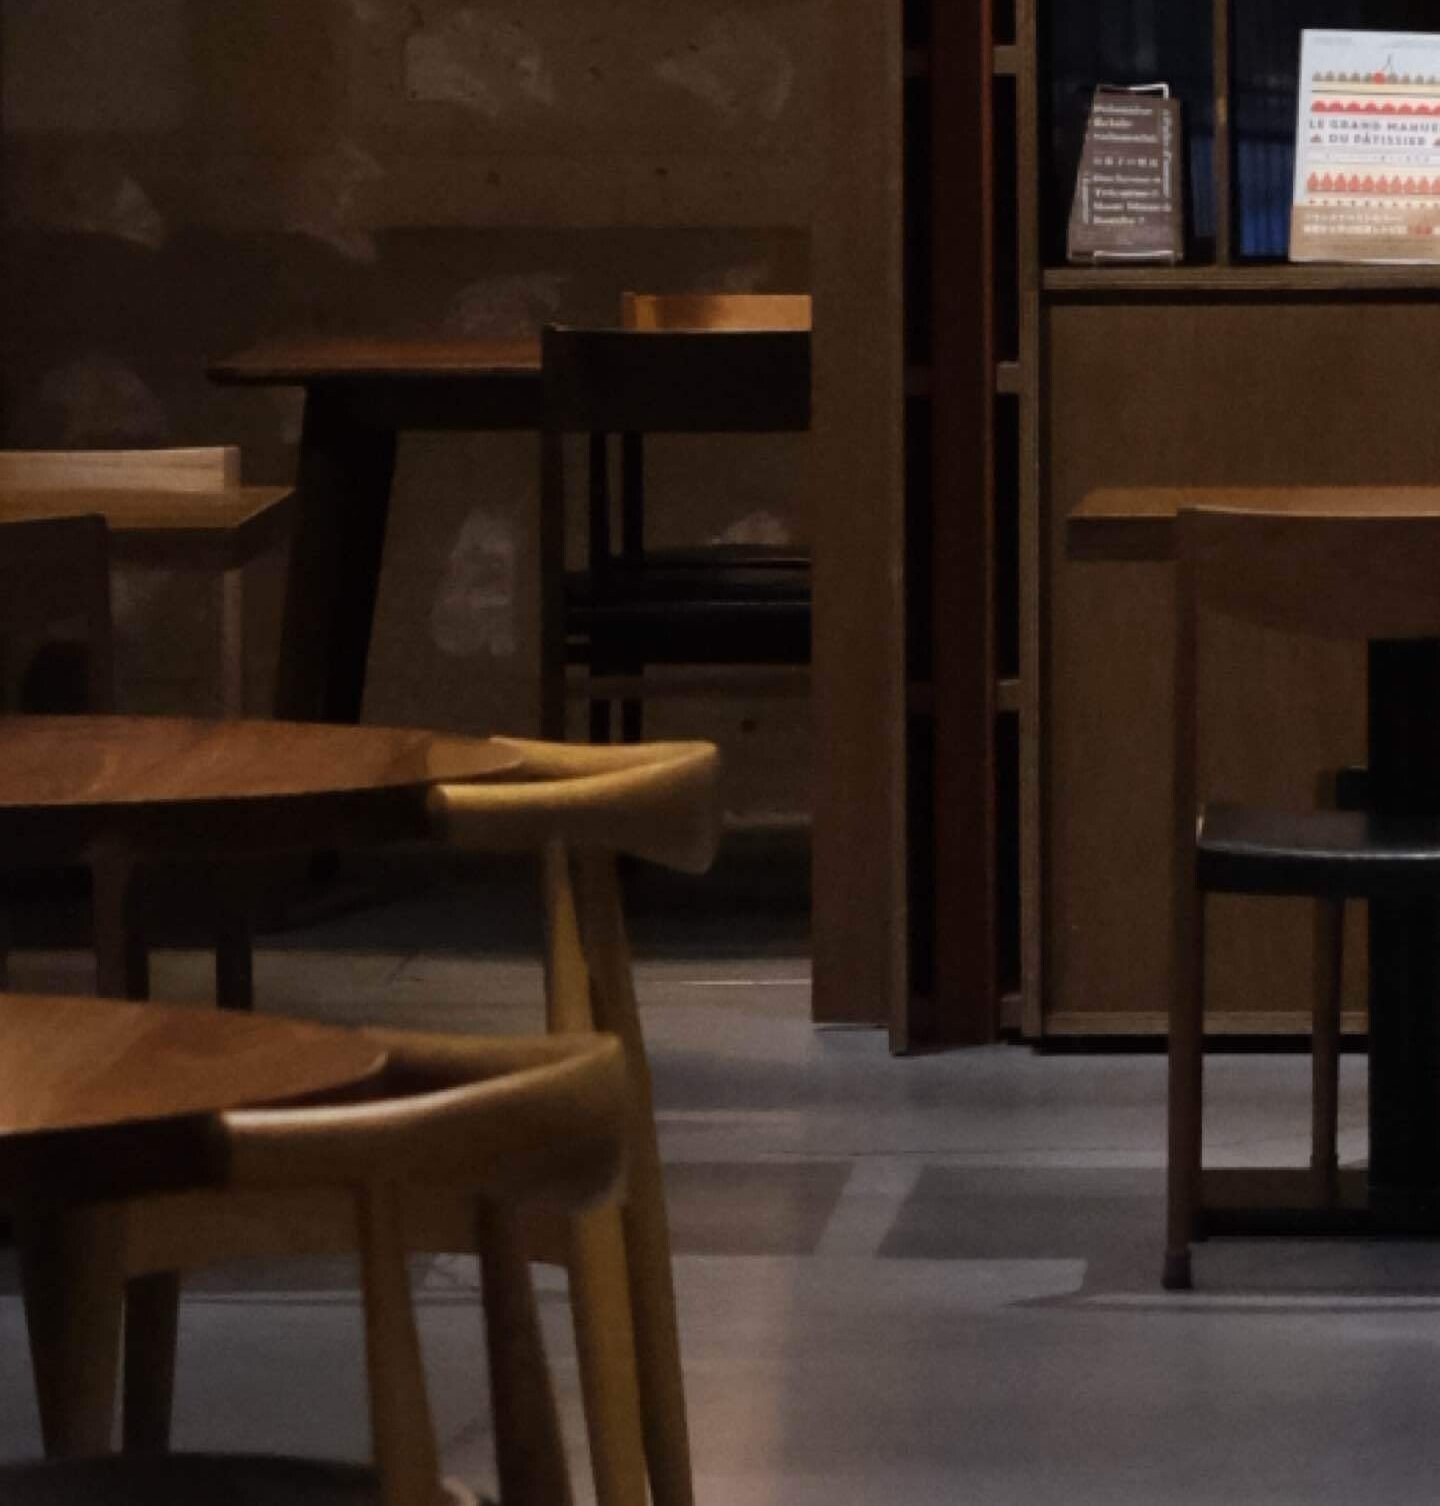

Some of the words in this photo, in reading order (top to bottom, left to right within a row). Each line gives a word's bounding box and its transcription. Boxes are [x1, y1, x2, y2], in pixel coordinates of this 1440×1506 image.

[1308, 118, 1325, 131] LE
[1329, 119, 1381, 132] GRAND
[1328, 134, 1350, 145] DU
[1353, 132, 1427, 147] PÂTISSIER
